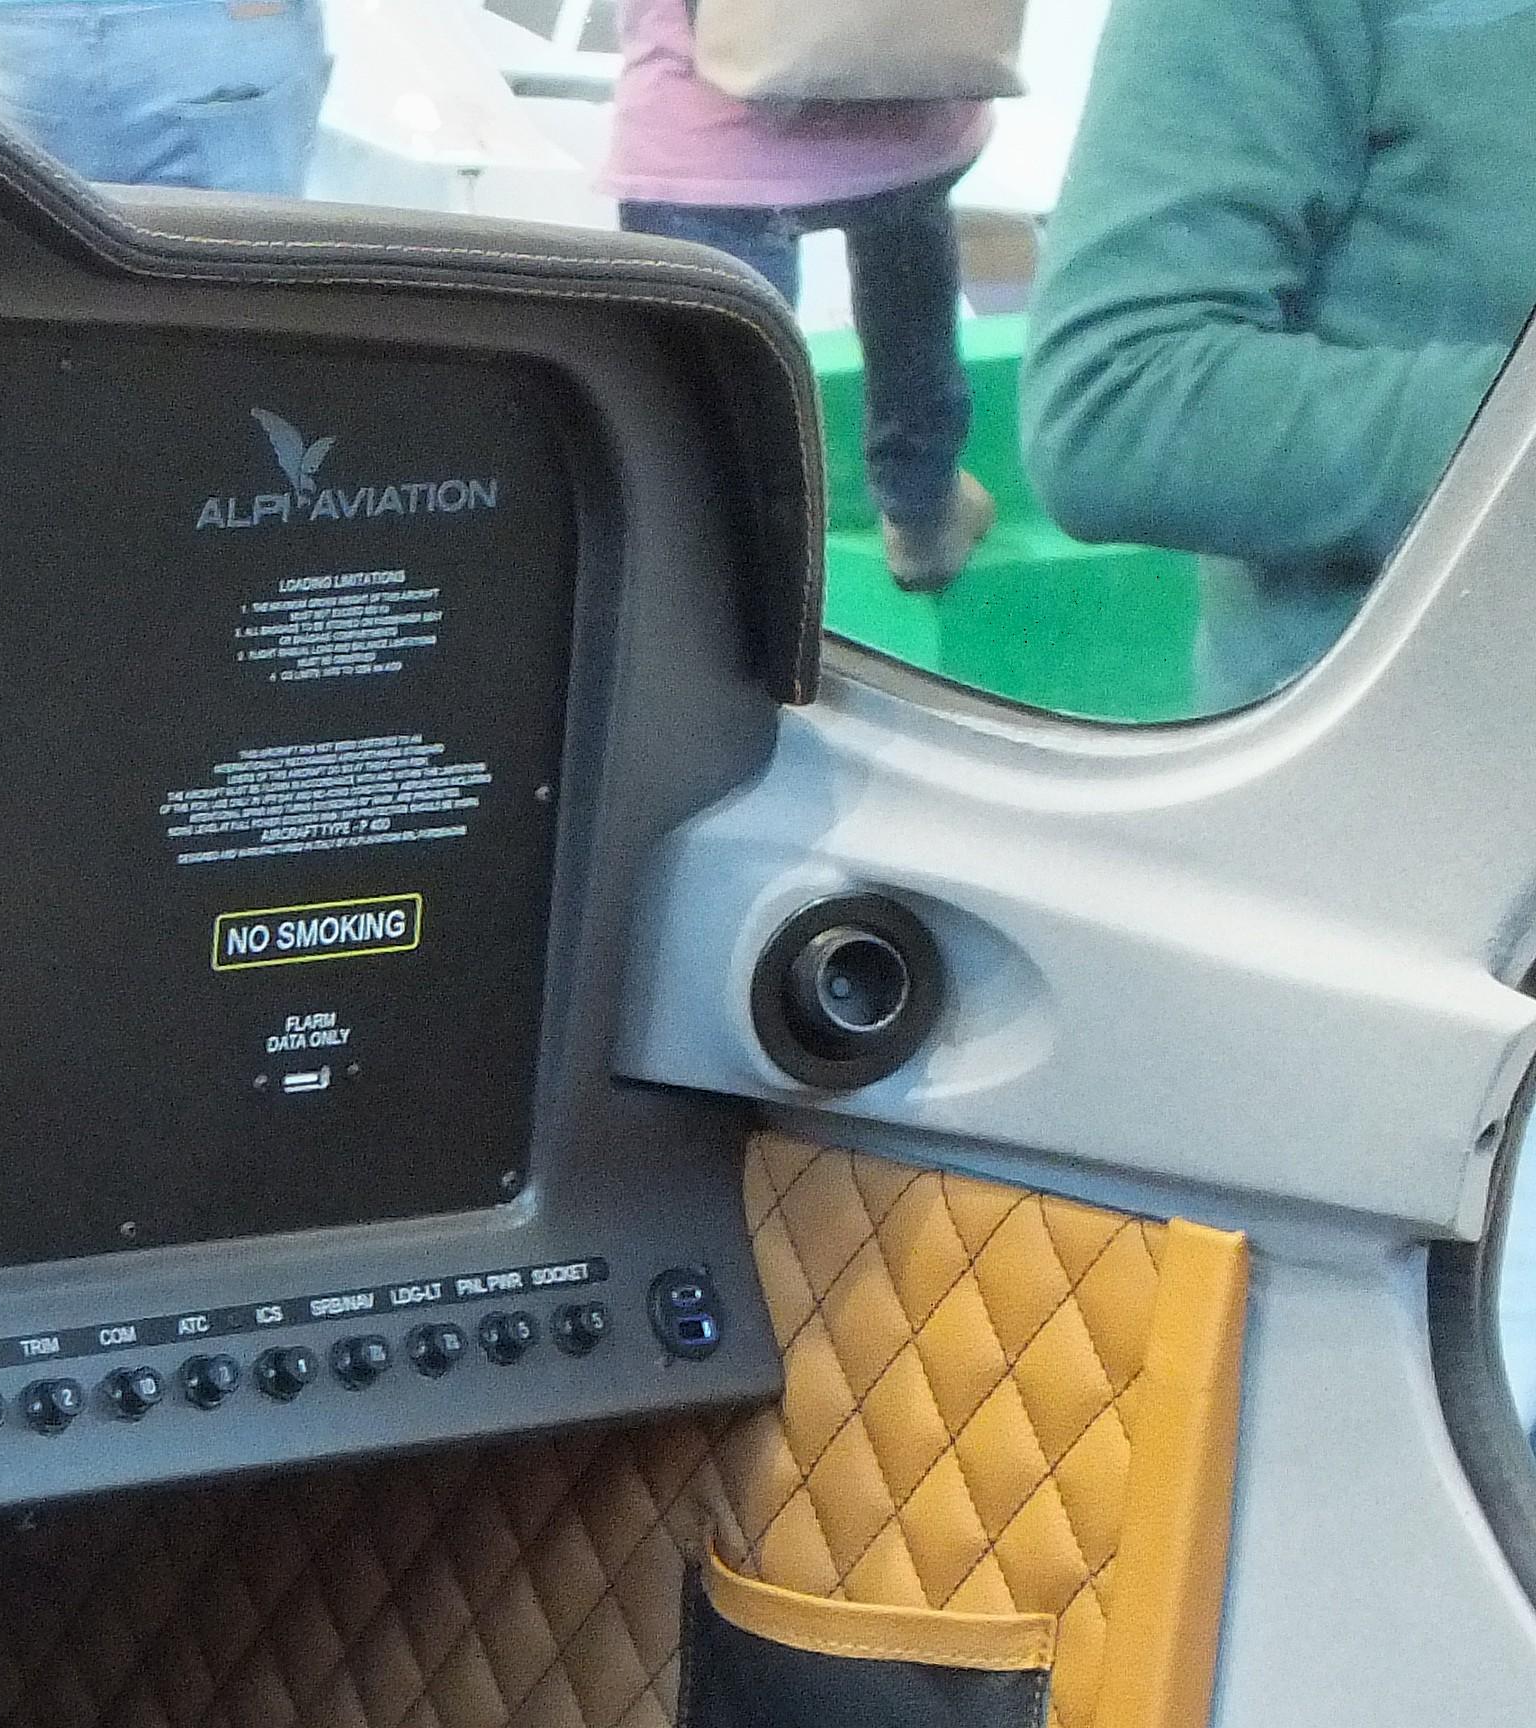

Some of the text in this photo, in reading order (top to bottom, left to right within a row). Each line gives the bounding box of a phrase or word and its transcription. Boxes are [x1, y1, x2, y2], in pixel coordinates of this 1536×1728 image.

[194, 478, 498, 531] ALPI AVIATION
[226, 908, 407, 957] NO SMOKING
[284, 1012, 337, 1032] FLARM
[266, 1027, 352, 1054] DATA ONLY
[530, 1263, 589, 1286] SOCKET
[390, 1282, 442, 1305] LDG-LT
[255, 1305, 284, 1324] ICS
[591, 1311, 604, 1329] 5
[98, 1325, 138, 1346] COM
[177, 1315, 211, 1336] ATC
[19, 1336, 60, 1356] TRIM
[61, 1387, 74, 1407] 2
